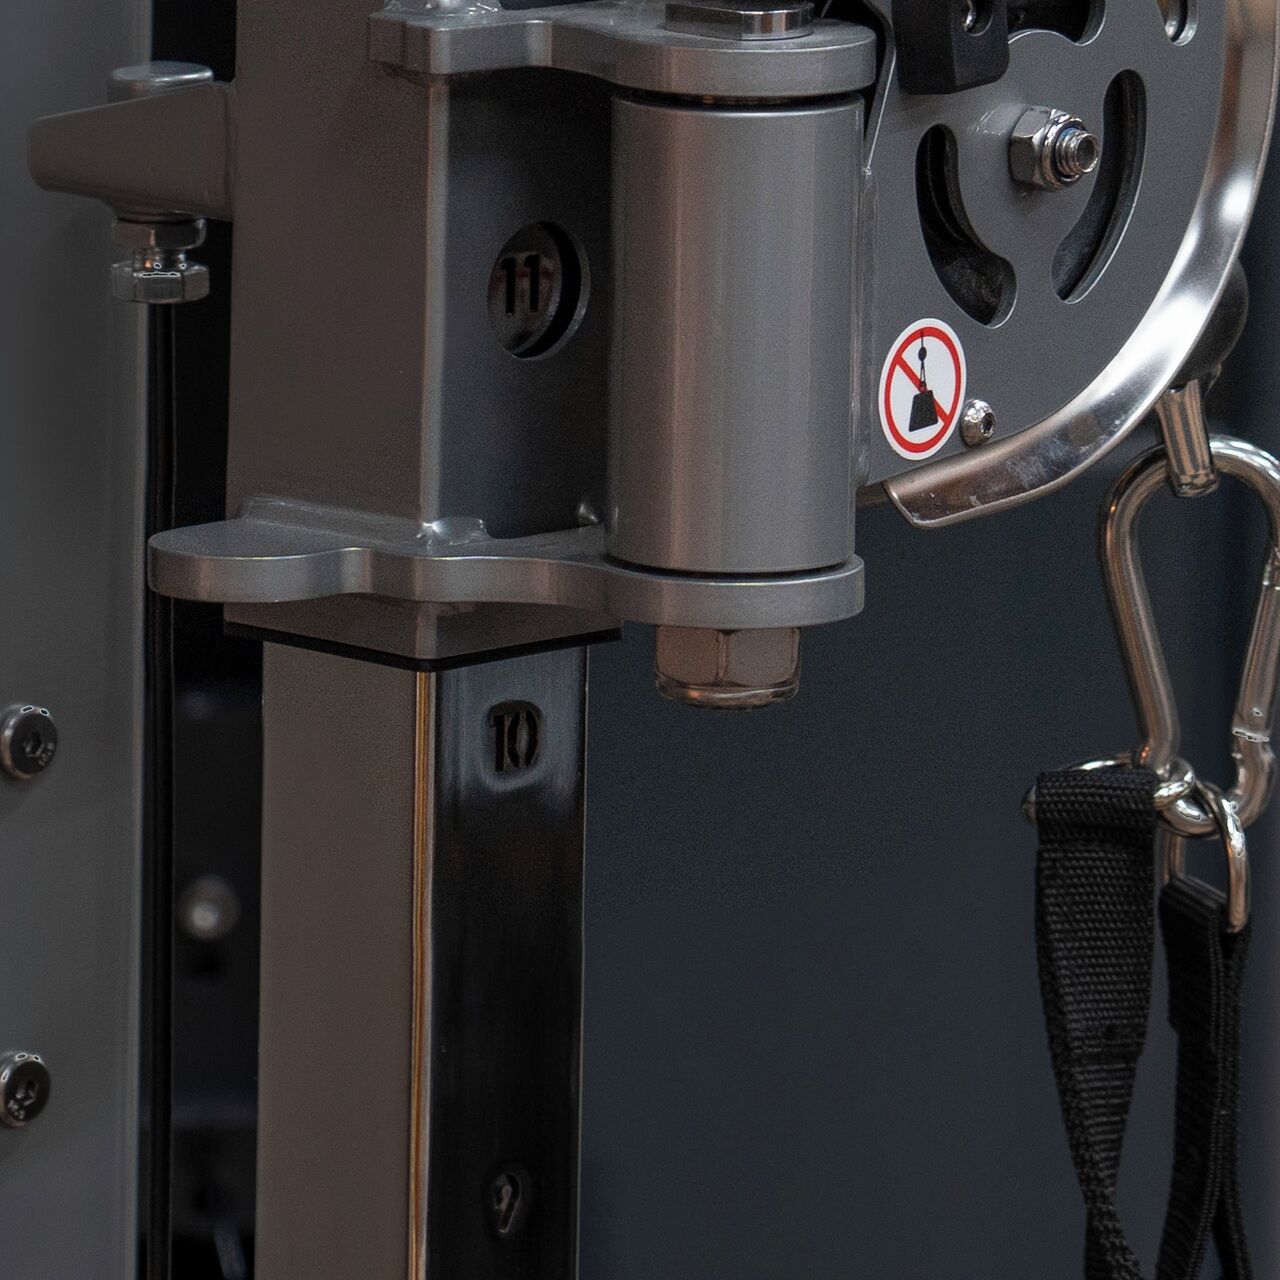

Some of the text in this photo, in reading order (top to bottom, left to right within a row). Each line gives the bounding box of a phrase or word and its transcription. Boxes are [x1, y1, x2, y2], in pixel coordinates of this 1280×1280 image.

[500, 253, 540, 316] 11
[488, 708, 539, 772] 10
[493, 1173, 520, 1235] 9
